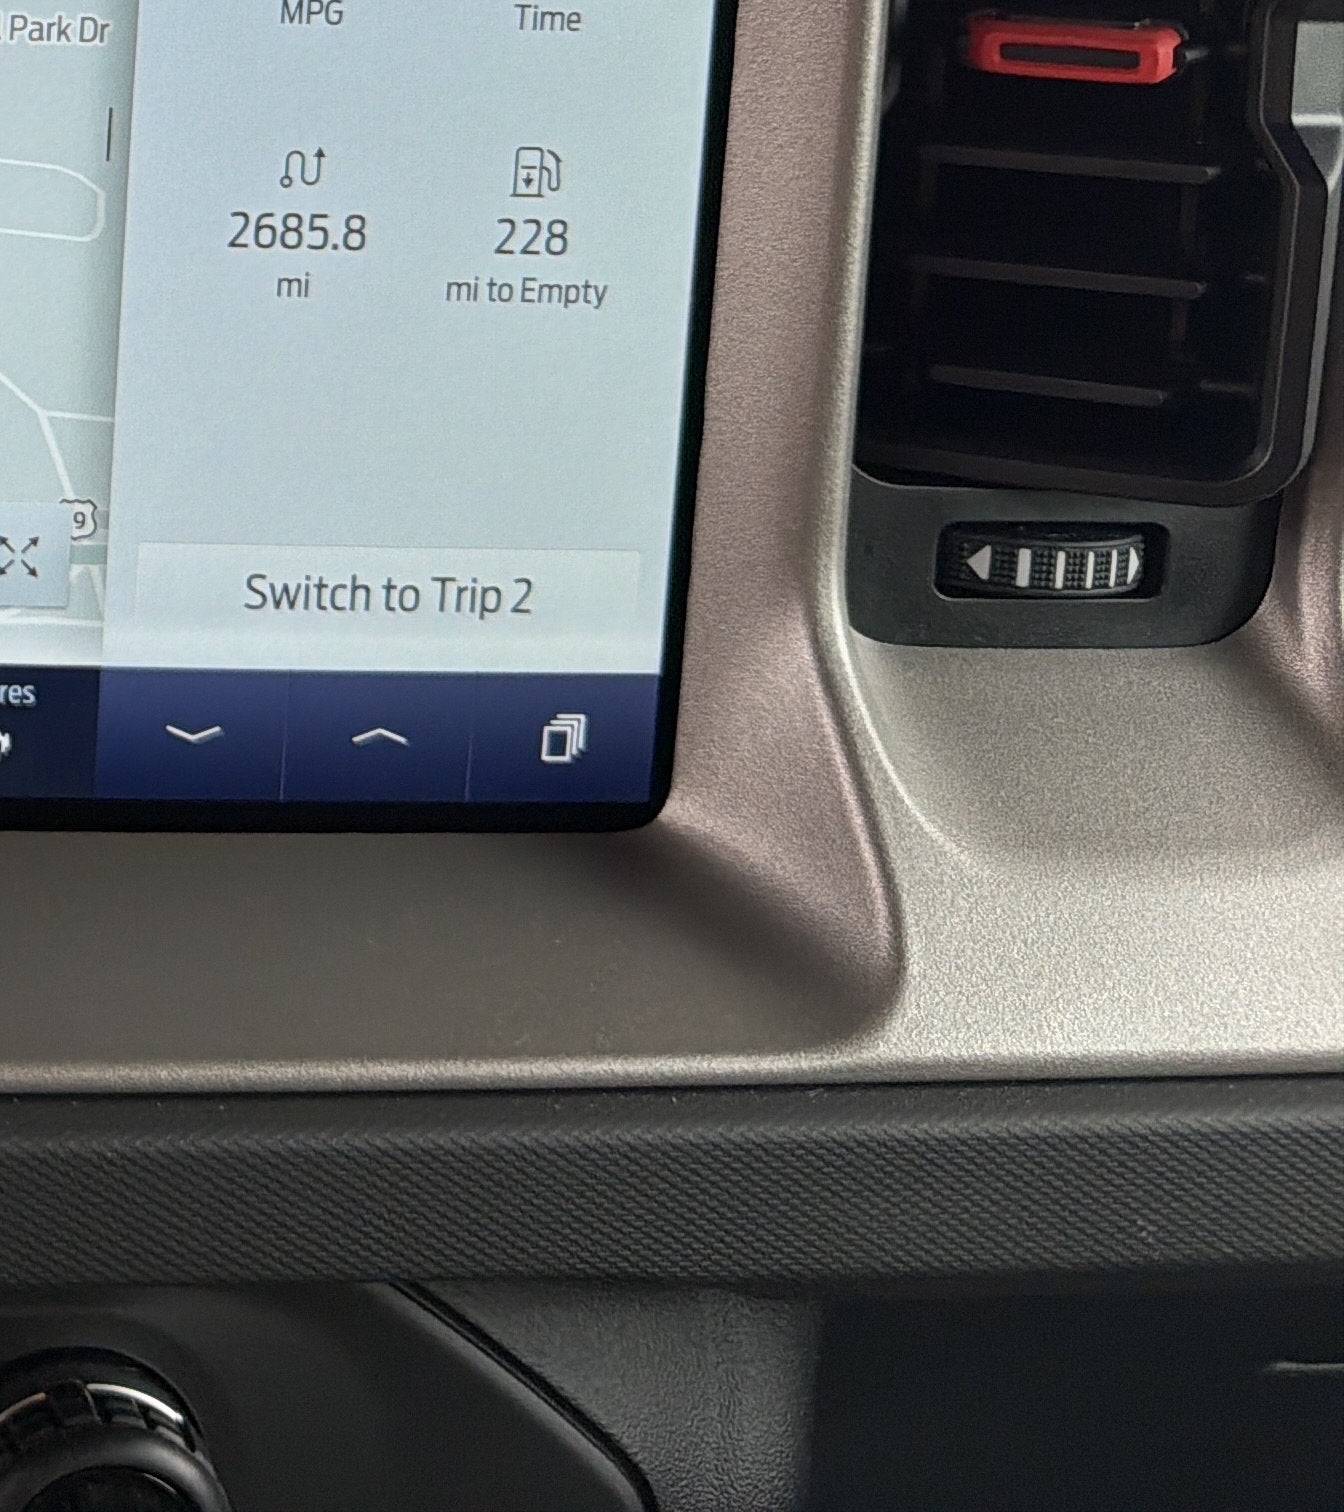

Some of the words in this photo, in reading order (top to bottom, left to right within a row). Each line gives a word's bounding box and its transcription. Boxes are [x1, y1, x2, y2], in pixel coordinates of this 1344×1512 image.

[9, 14, 72, 43] Park
[79, 16, 110, 44] Dr
[514, 4, 583, 33] Time
[226, 211, 368, 252] 2685.8
[493, 218, 570, 256] 228
[276, 271, 310, 298] mi
[445, 277, 480, 302] mi
[486, 278, 513, 303] to
[519, 279, 608, 309] Empty
[243, 574, 372, 614] Switch
[382, 577, 420, 612] to
[431, 577, 502, 621] Trip
[510, 579, 533, 614] 2
